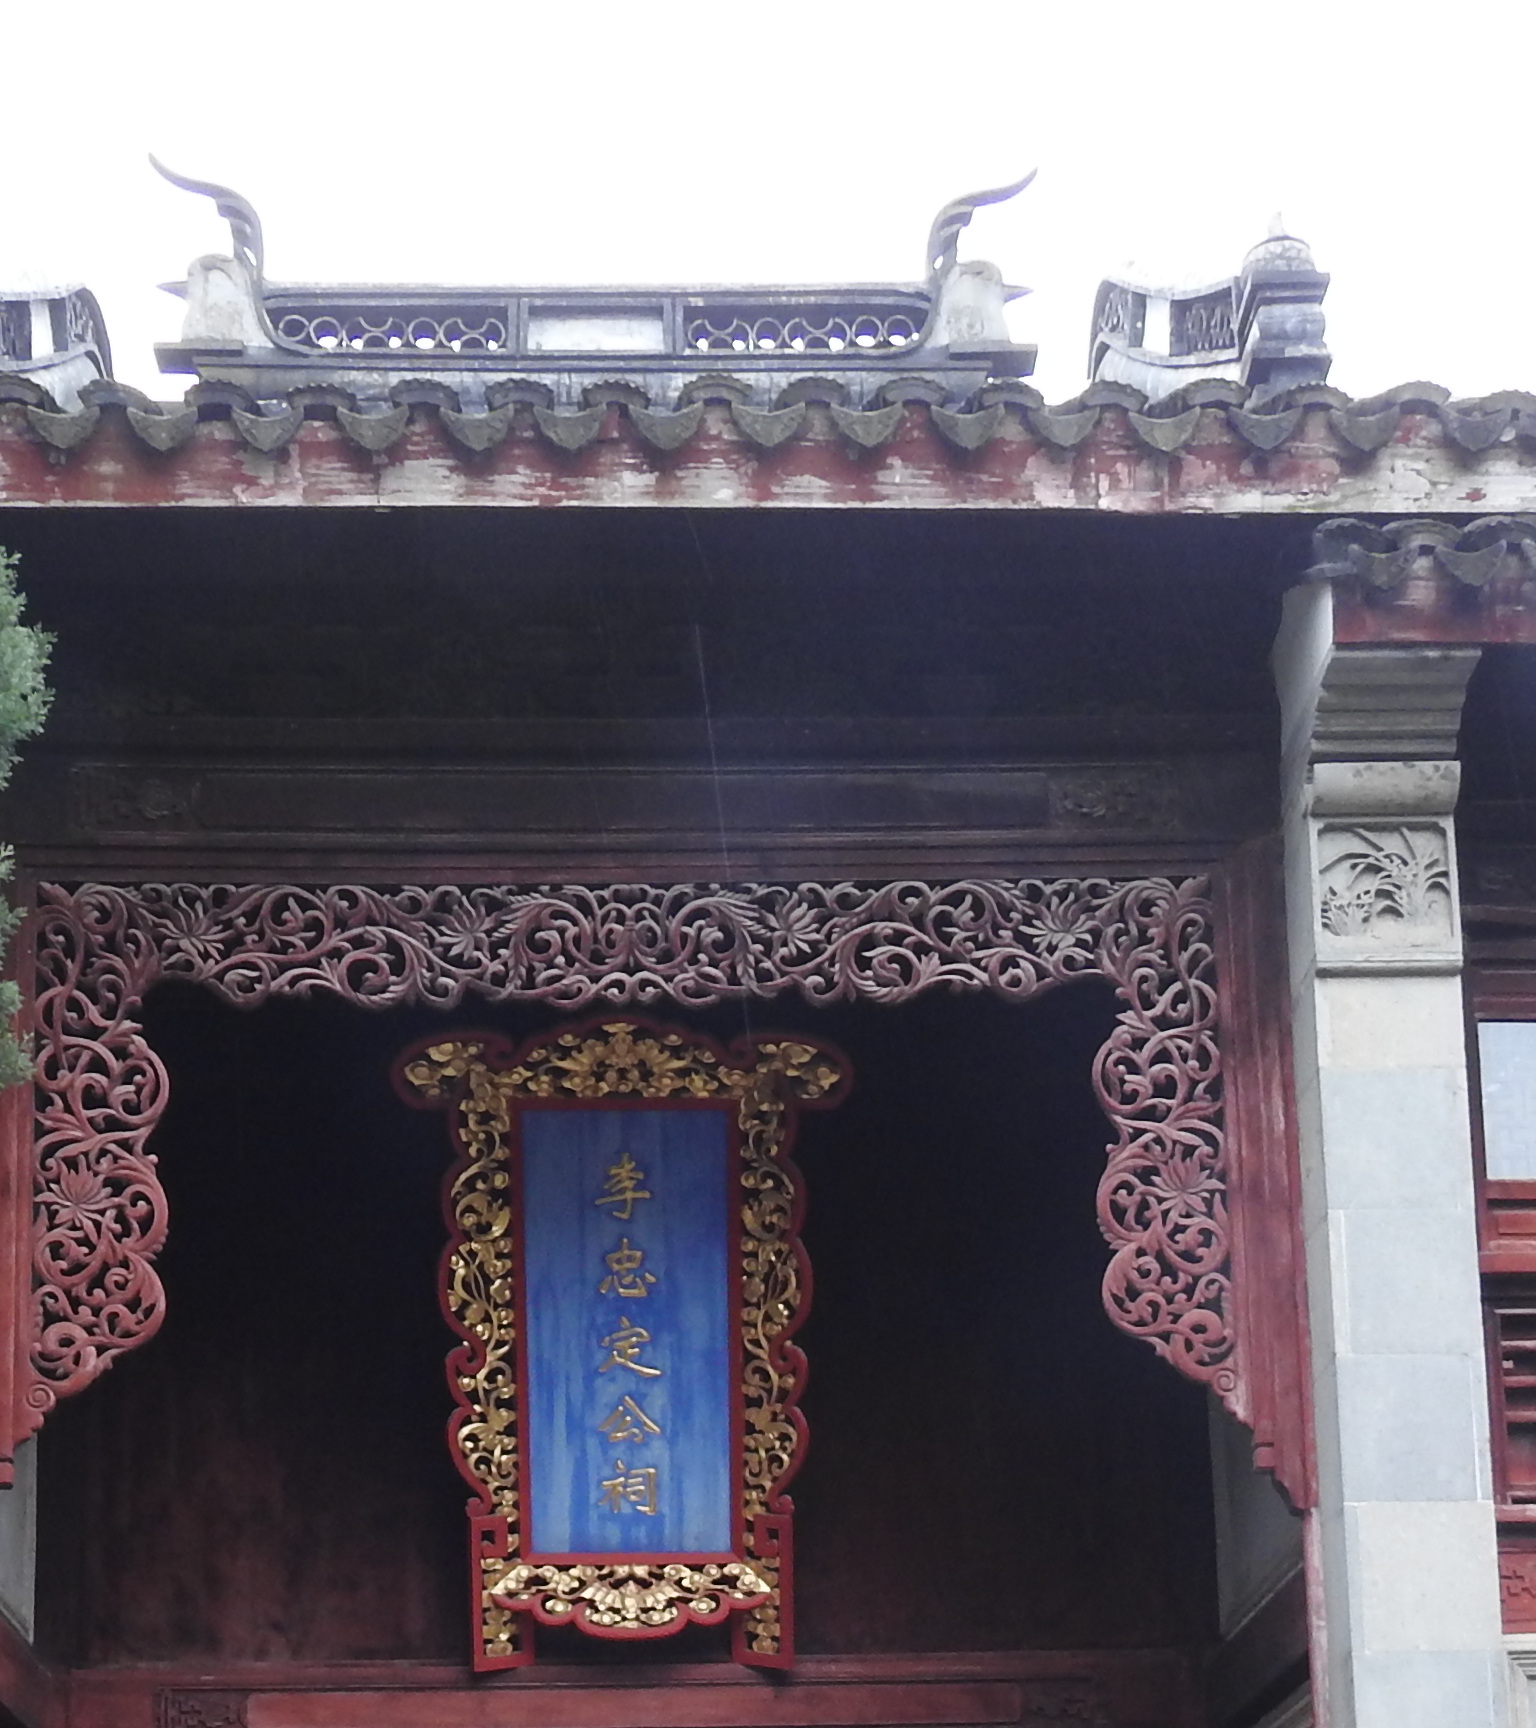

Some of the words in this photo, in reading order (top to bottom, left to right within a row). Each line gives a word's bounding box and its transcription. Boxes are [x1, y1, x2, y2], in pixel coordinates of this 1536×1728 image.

[595, 1152, 662, 1516] 李忠定公祠
